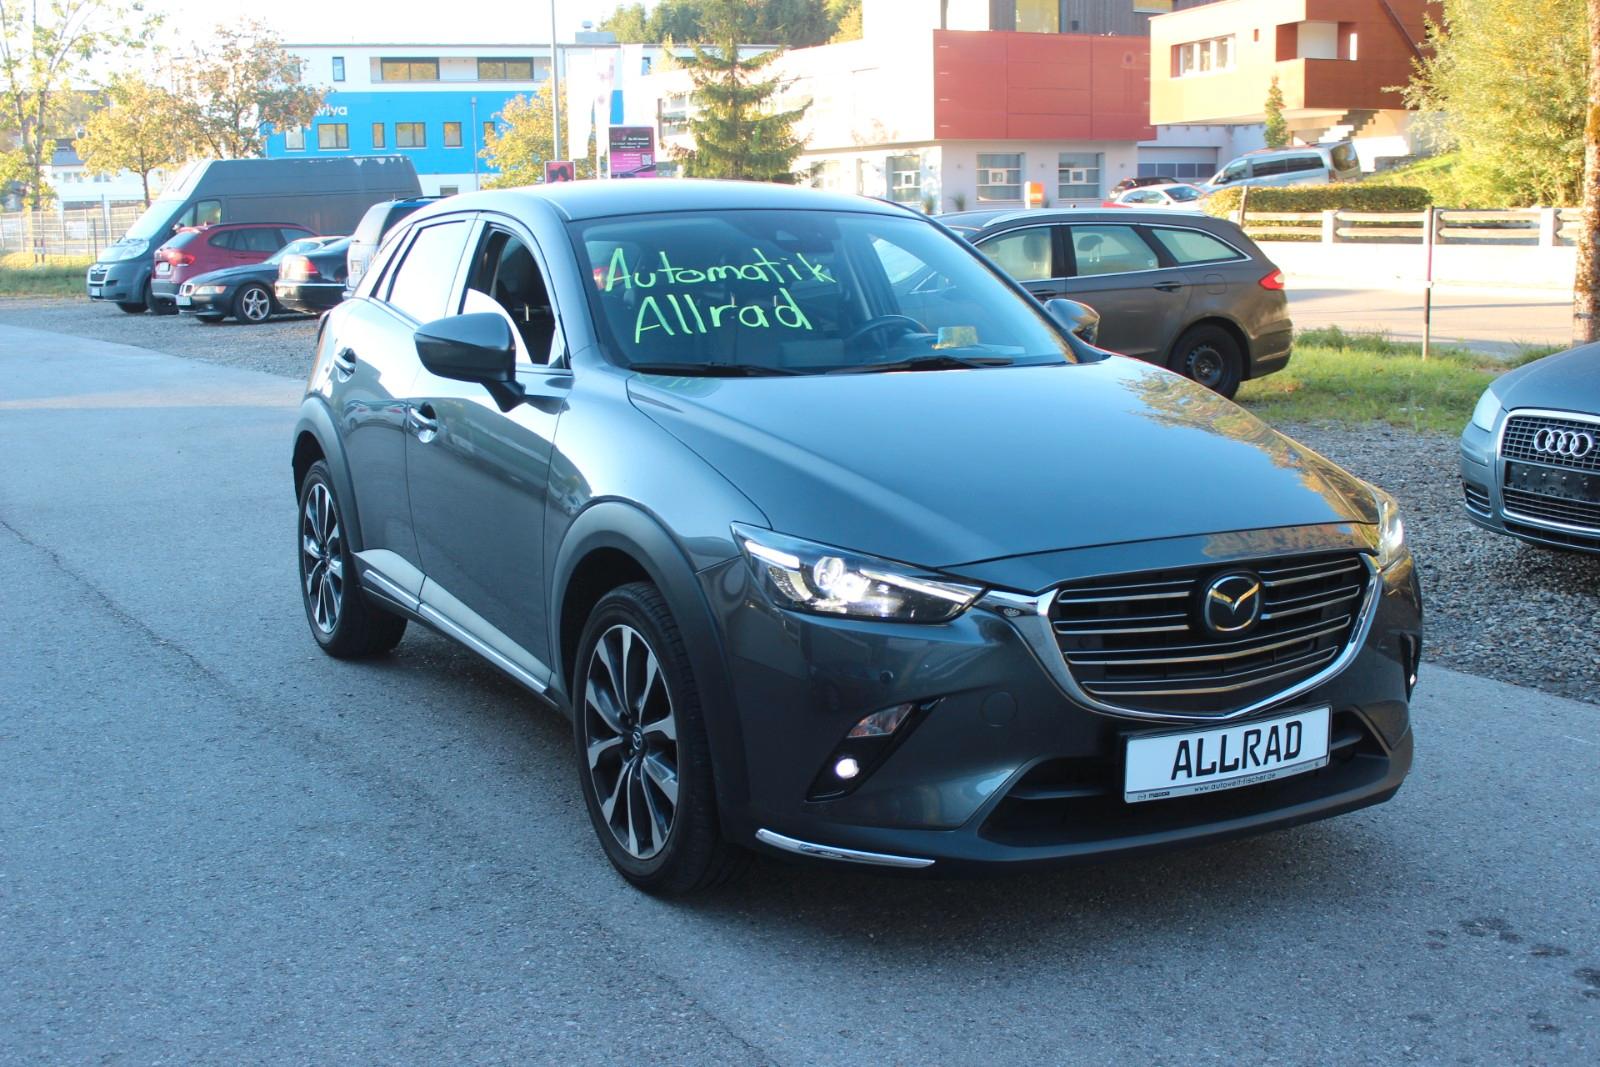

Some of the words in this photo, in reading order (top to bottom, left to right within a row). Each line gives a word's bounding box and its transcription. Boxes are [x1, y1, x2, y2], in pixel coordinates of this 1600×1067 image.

[605, 247, 836, 292] Automatik
[635, 287, 813, 344] Allrad
[1171, 720, 1302, 780] ALLRAD
